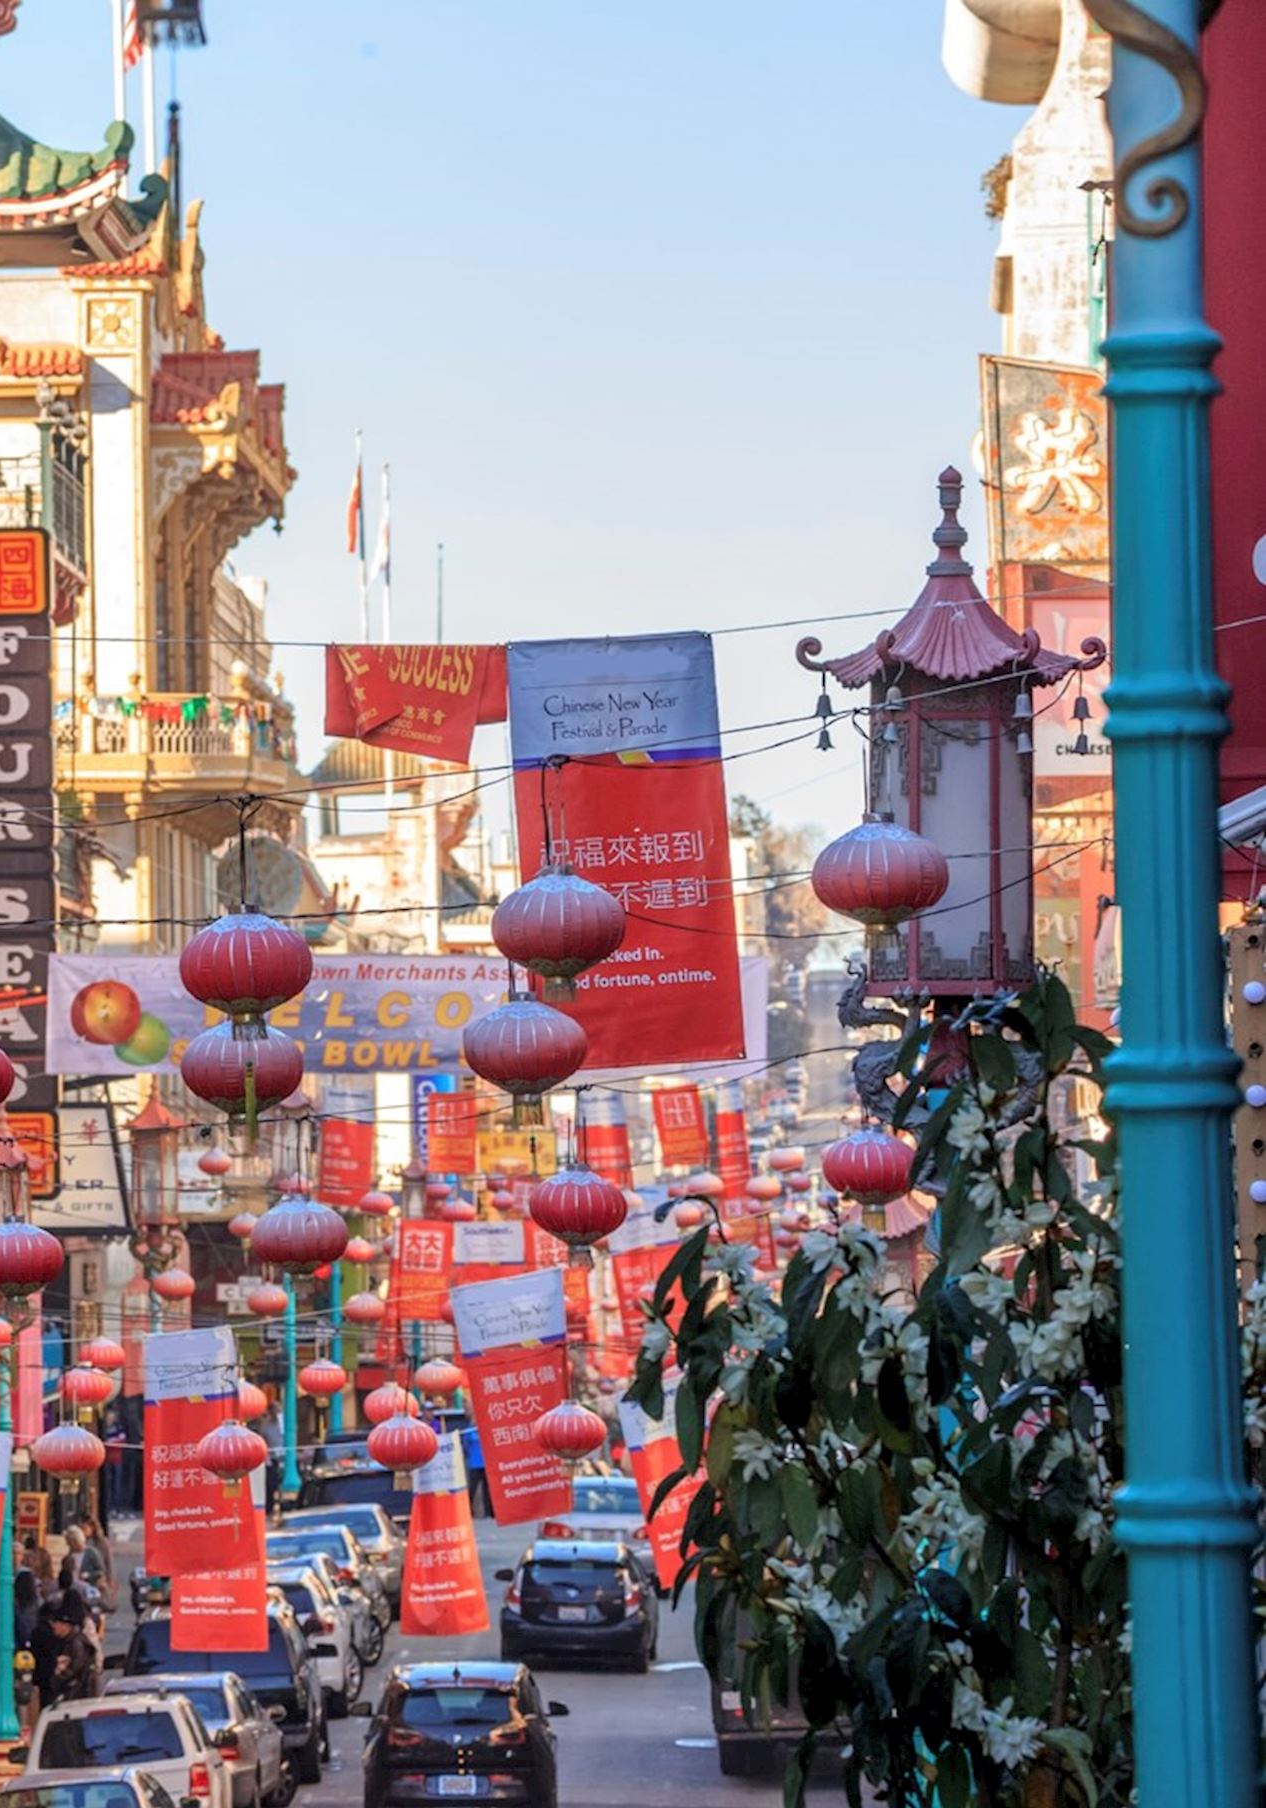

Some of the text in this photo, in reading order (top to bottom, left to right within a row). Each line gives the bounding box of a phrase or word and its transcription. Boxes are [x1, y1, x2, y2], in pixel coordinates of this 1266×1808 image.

[388, 645, 478, 696] SUCCESS
[543, 691, 679, 717] Chinese New Year
[551, 716, 668, 741] Festival & Parade
[598, 876, 709, 911] 不遲到
[602, 946, 664, 964] cked in.
[310, 963, 529, 981] own Merchants Asso
[593, 971, 655, 988] fortune,
[657, 968, 717, 984] ontime.
[322, 1040, 441, 1067] BOWL
[71, 1202, 114, 1212] GIFTS
[491, 1423, 535, 1447] 西南
